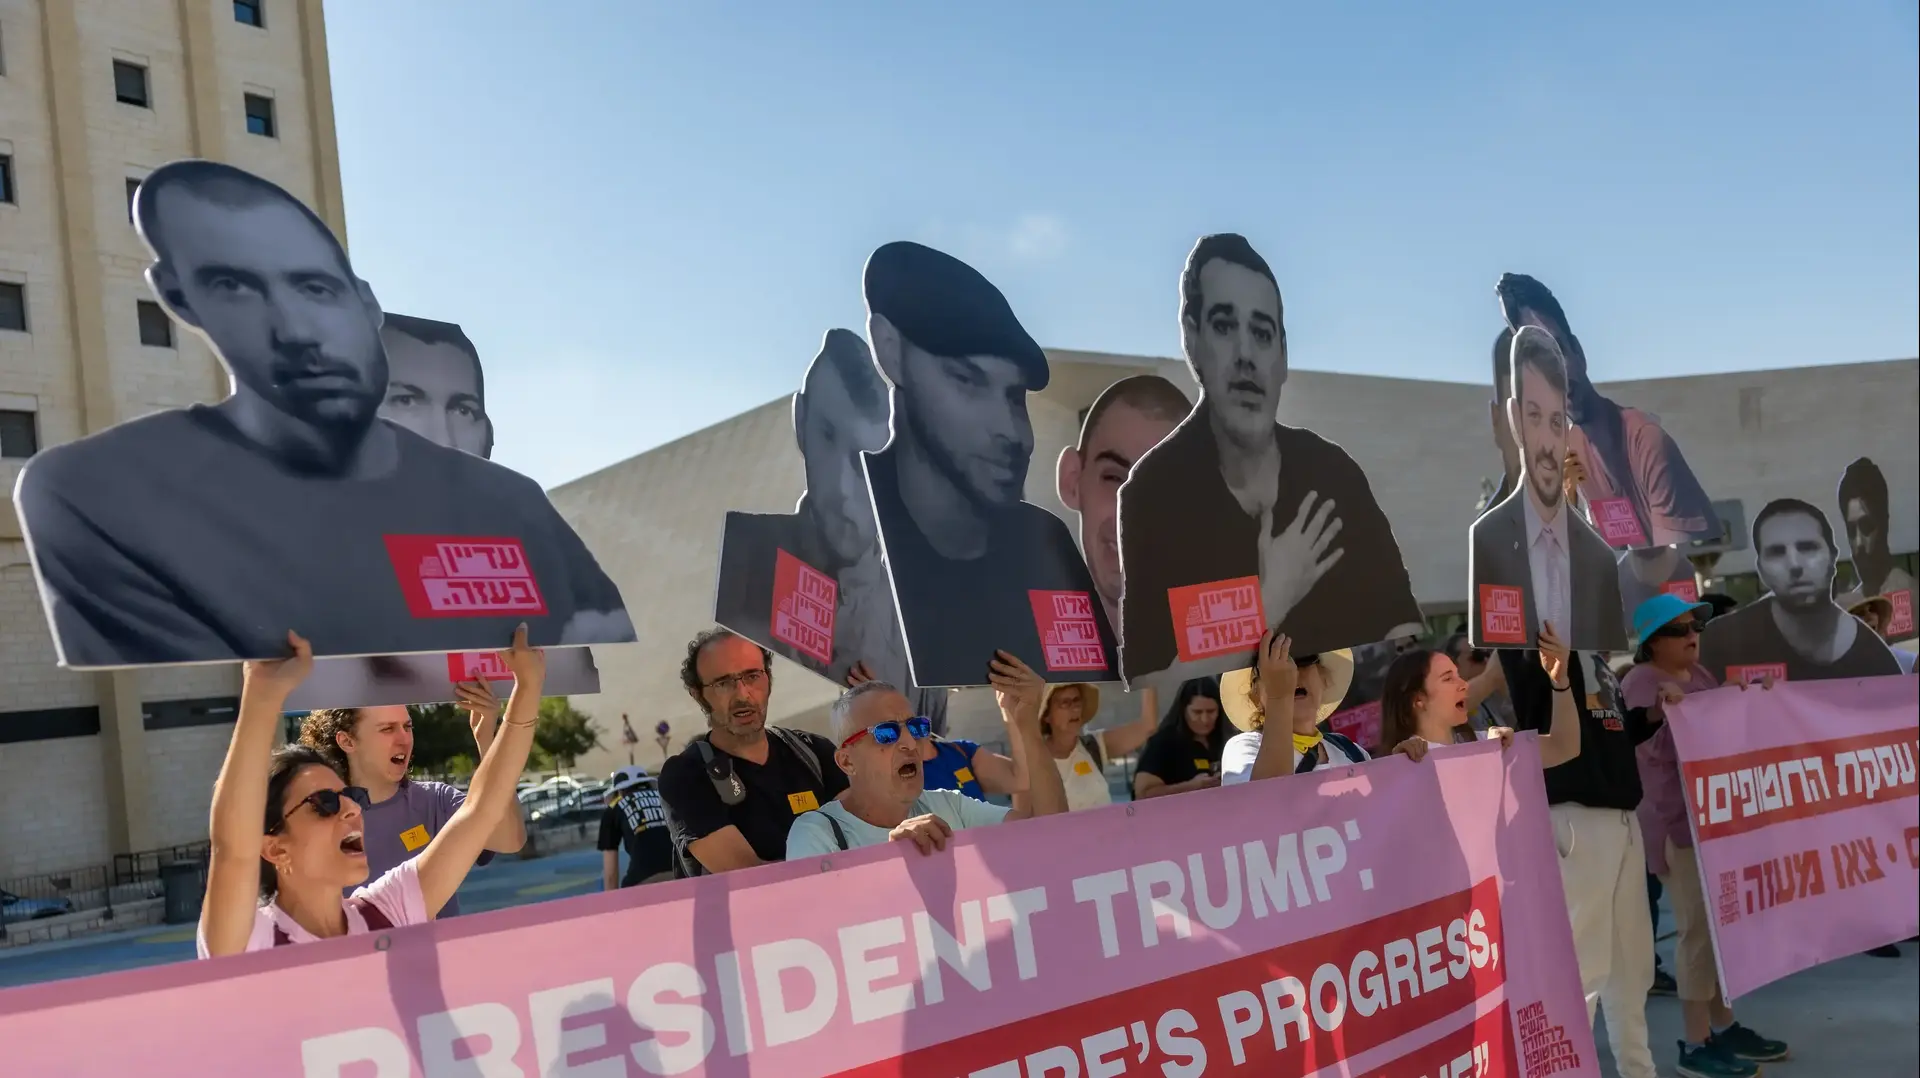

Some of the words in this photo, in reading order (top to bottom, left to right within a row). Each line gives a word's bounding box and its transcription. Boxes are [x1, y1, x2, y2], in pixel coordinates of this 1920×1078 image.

[443, 546, 521, 574] עדיין
[443, 580, 537, 605] בעזה.
[1055, 596, 1091, 617] אלון
[1203, 587, 1253, 620] עדיין
[794, 594, 831, 629] עדיין
[783, 618, 829, 657] בעזה.
[1056, 623, 1095, 643] עדיין
[1198, 619, 1261, 650] בעזה.
[1056, 647, 1103, 664] בעזה.
[1695, 756, 1831, 826] החטופים!
[1830, 837, 1886, 890] צאו
[1072, 819, 1375, 959] TRUMP:
[1743, 850, 1825, 915] מעזה
[1217, 908, 1499, 1067] PROGRESS,
